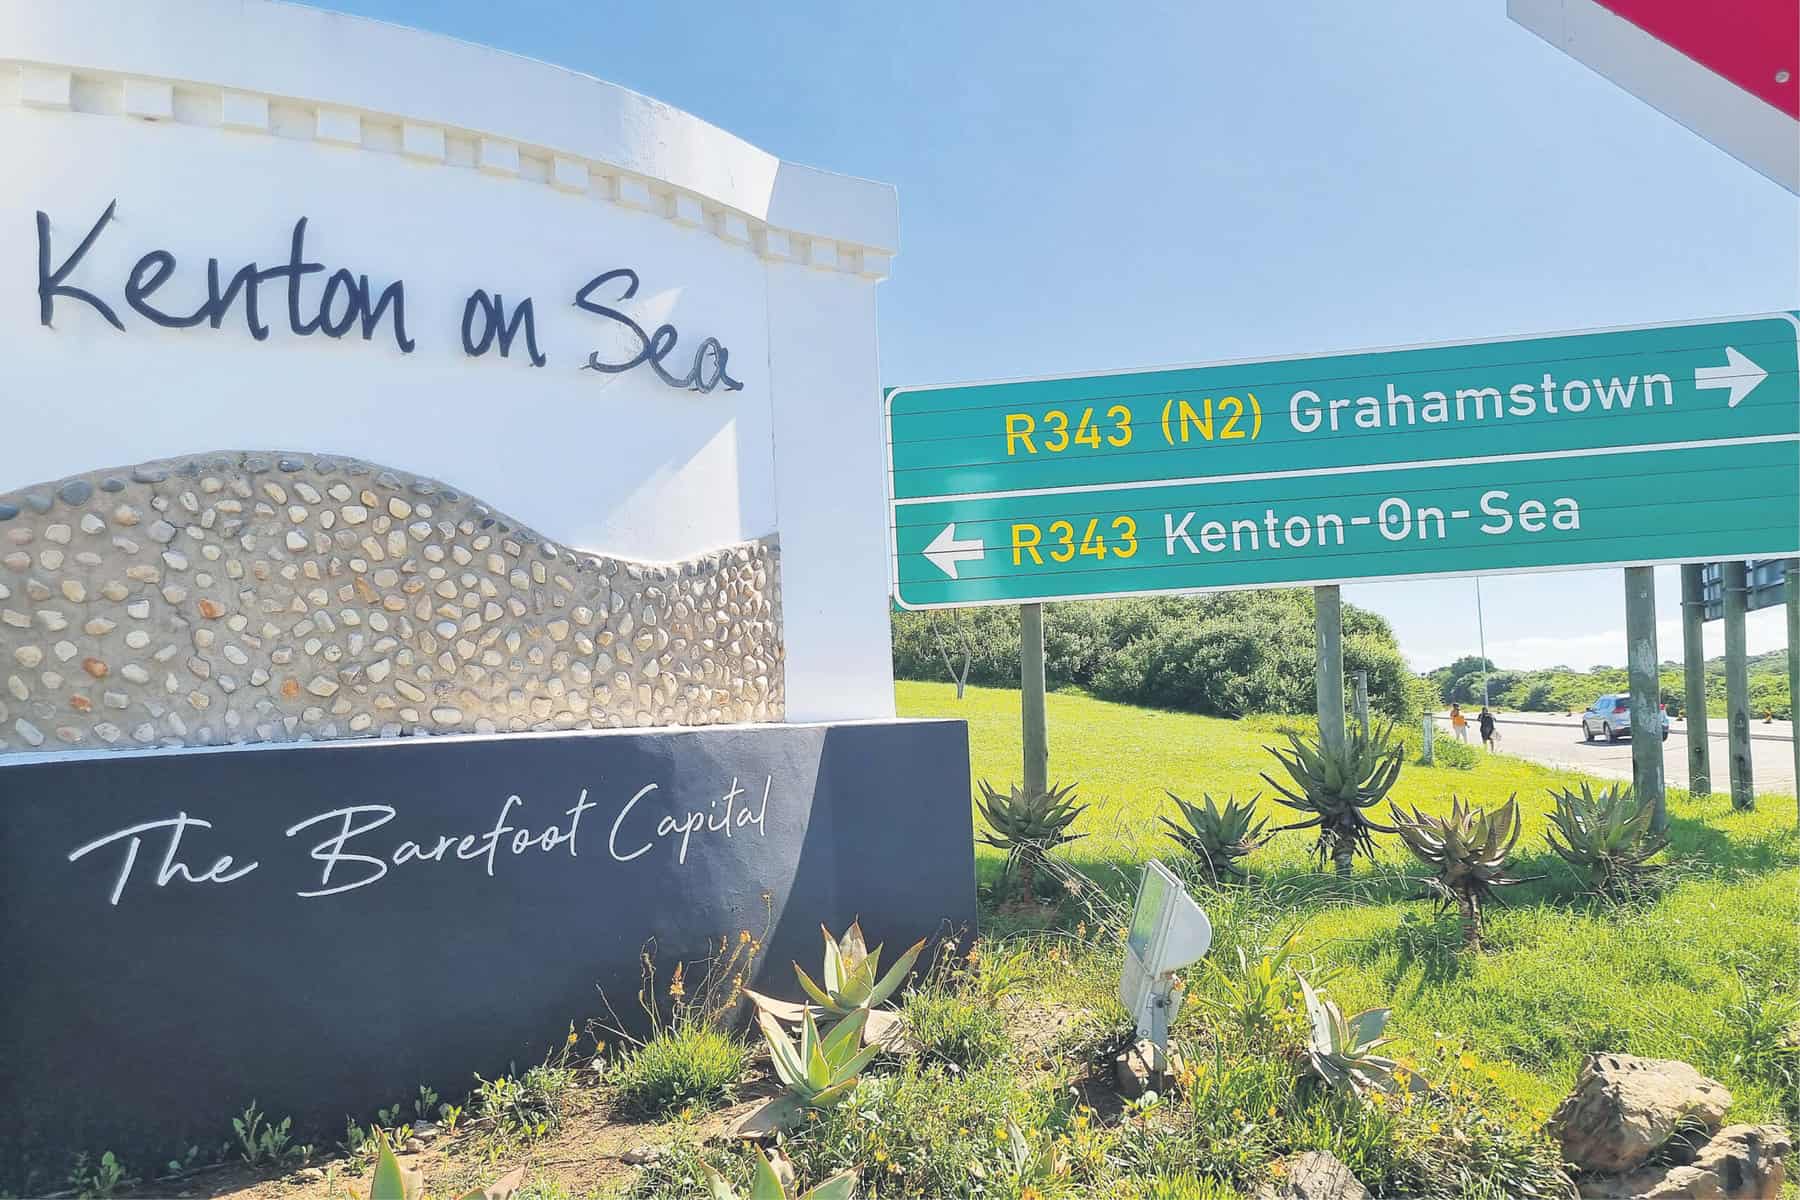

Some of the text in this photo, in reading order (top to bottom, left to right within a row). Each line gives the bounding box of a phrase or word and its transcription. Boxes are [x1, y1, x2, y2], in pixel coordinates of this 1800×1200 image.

[36, 198, 744, 393] Kenton on Sea
[1004, 372, 1674, 456] R343 (N2) Grahamstown
[1010, 489, 1582, 566] R343 Kenton-On-Sea
[68, 774, 772, 906] The Barefoot Capital
